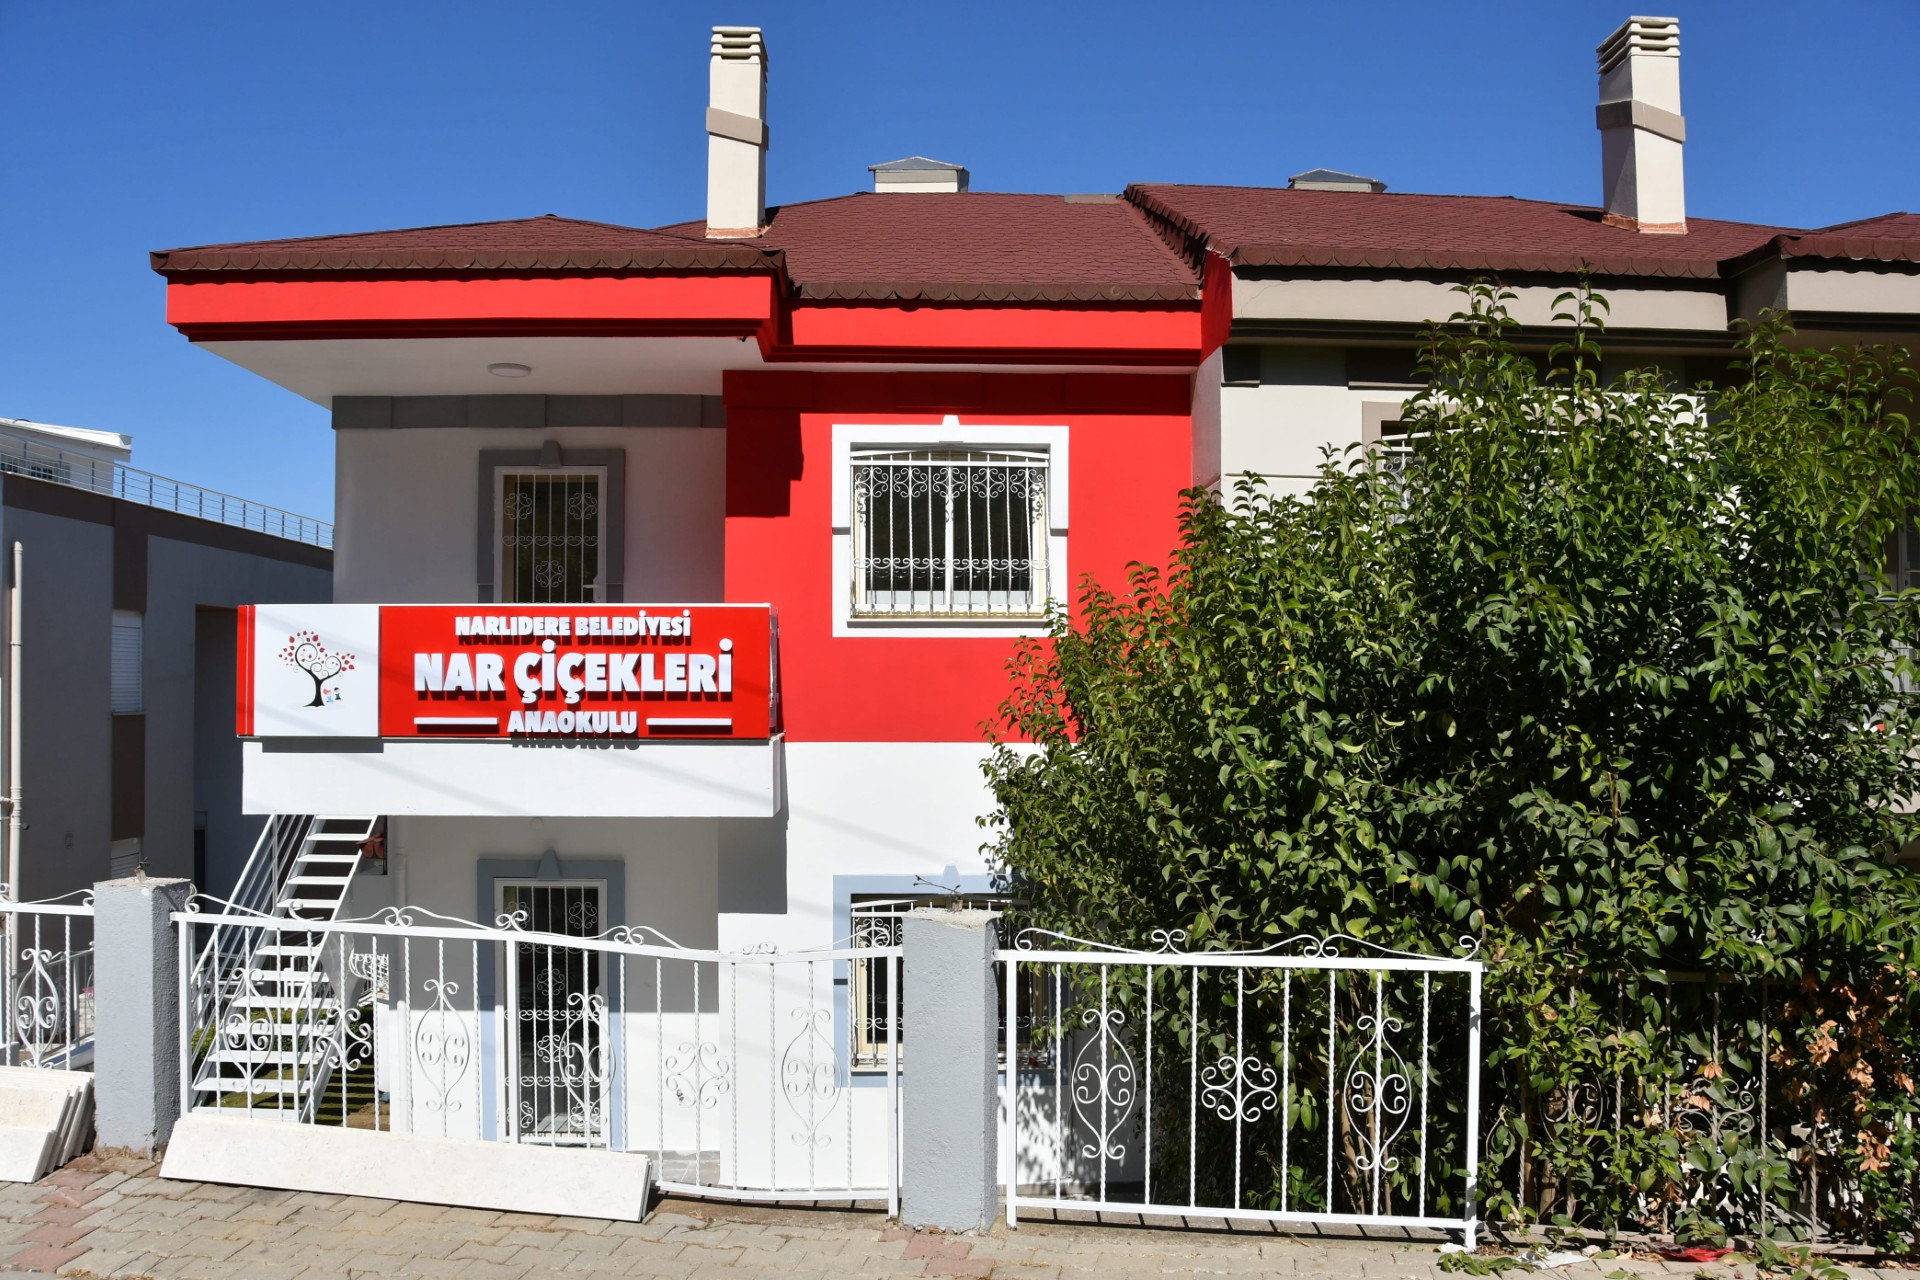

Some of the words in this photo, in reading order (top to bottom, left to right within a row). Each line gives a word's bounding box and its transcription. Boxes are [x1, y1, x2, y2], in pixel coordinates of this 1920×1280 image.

[455, 616, 571, 637] NARLIDERE
[575, 610, 691, 637] BELEDİYESİ
[414, 653, 506, 692] NAR
[514, 639, 732, 703] ÇİÇEKLERİ
[507, 711, 638, 734] ANAOKULU
